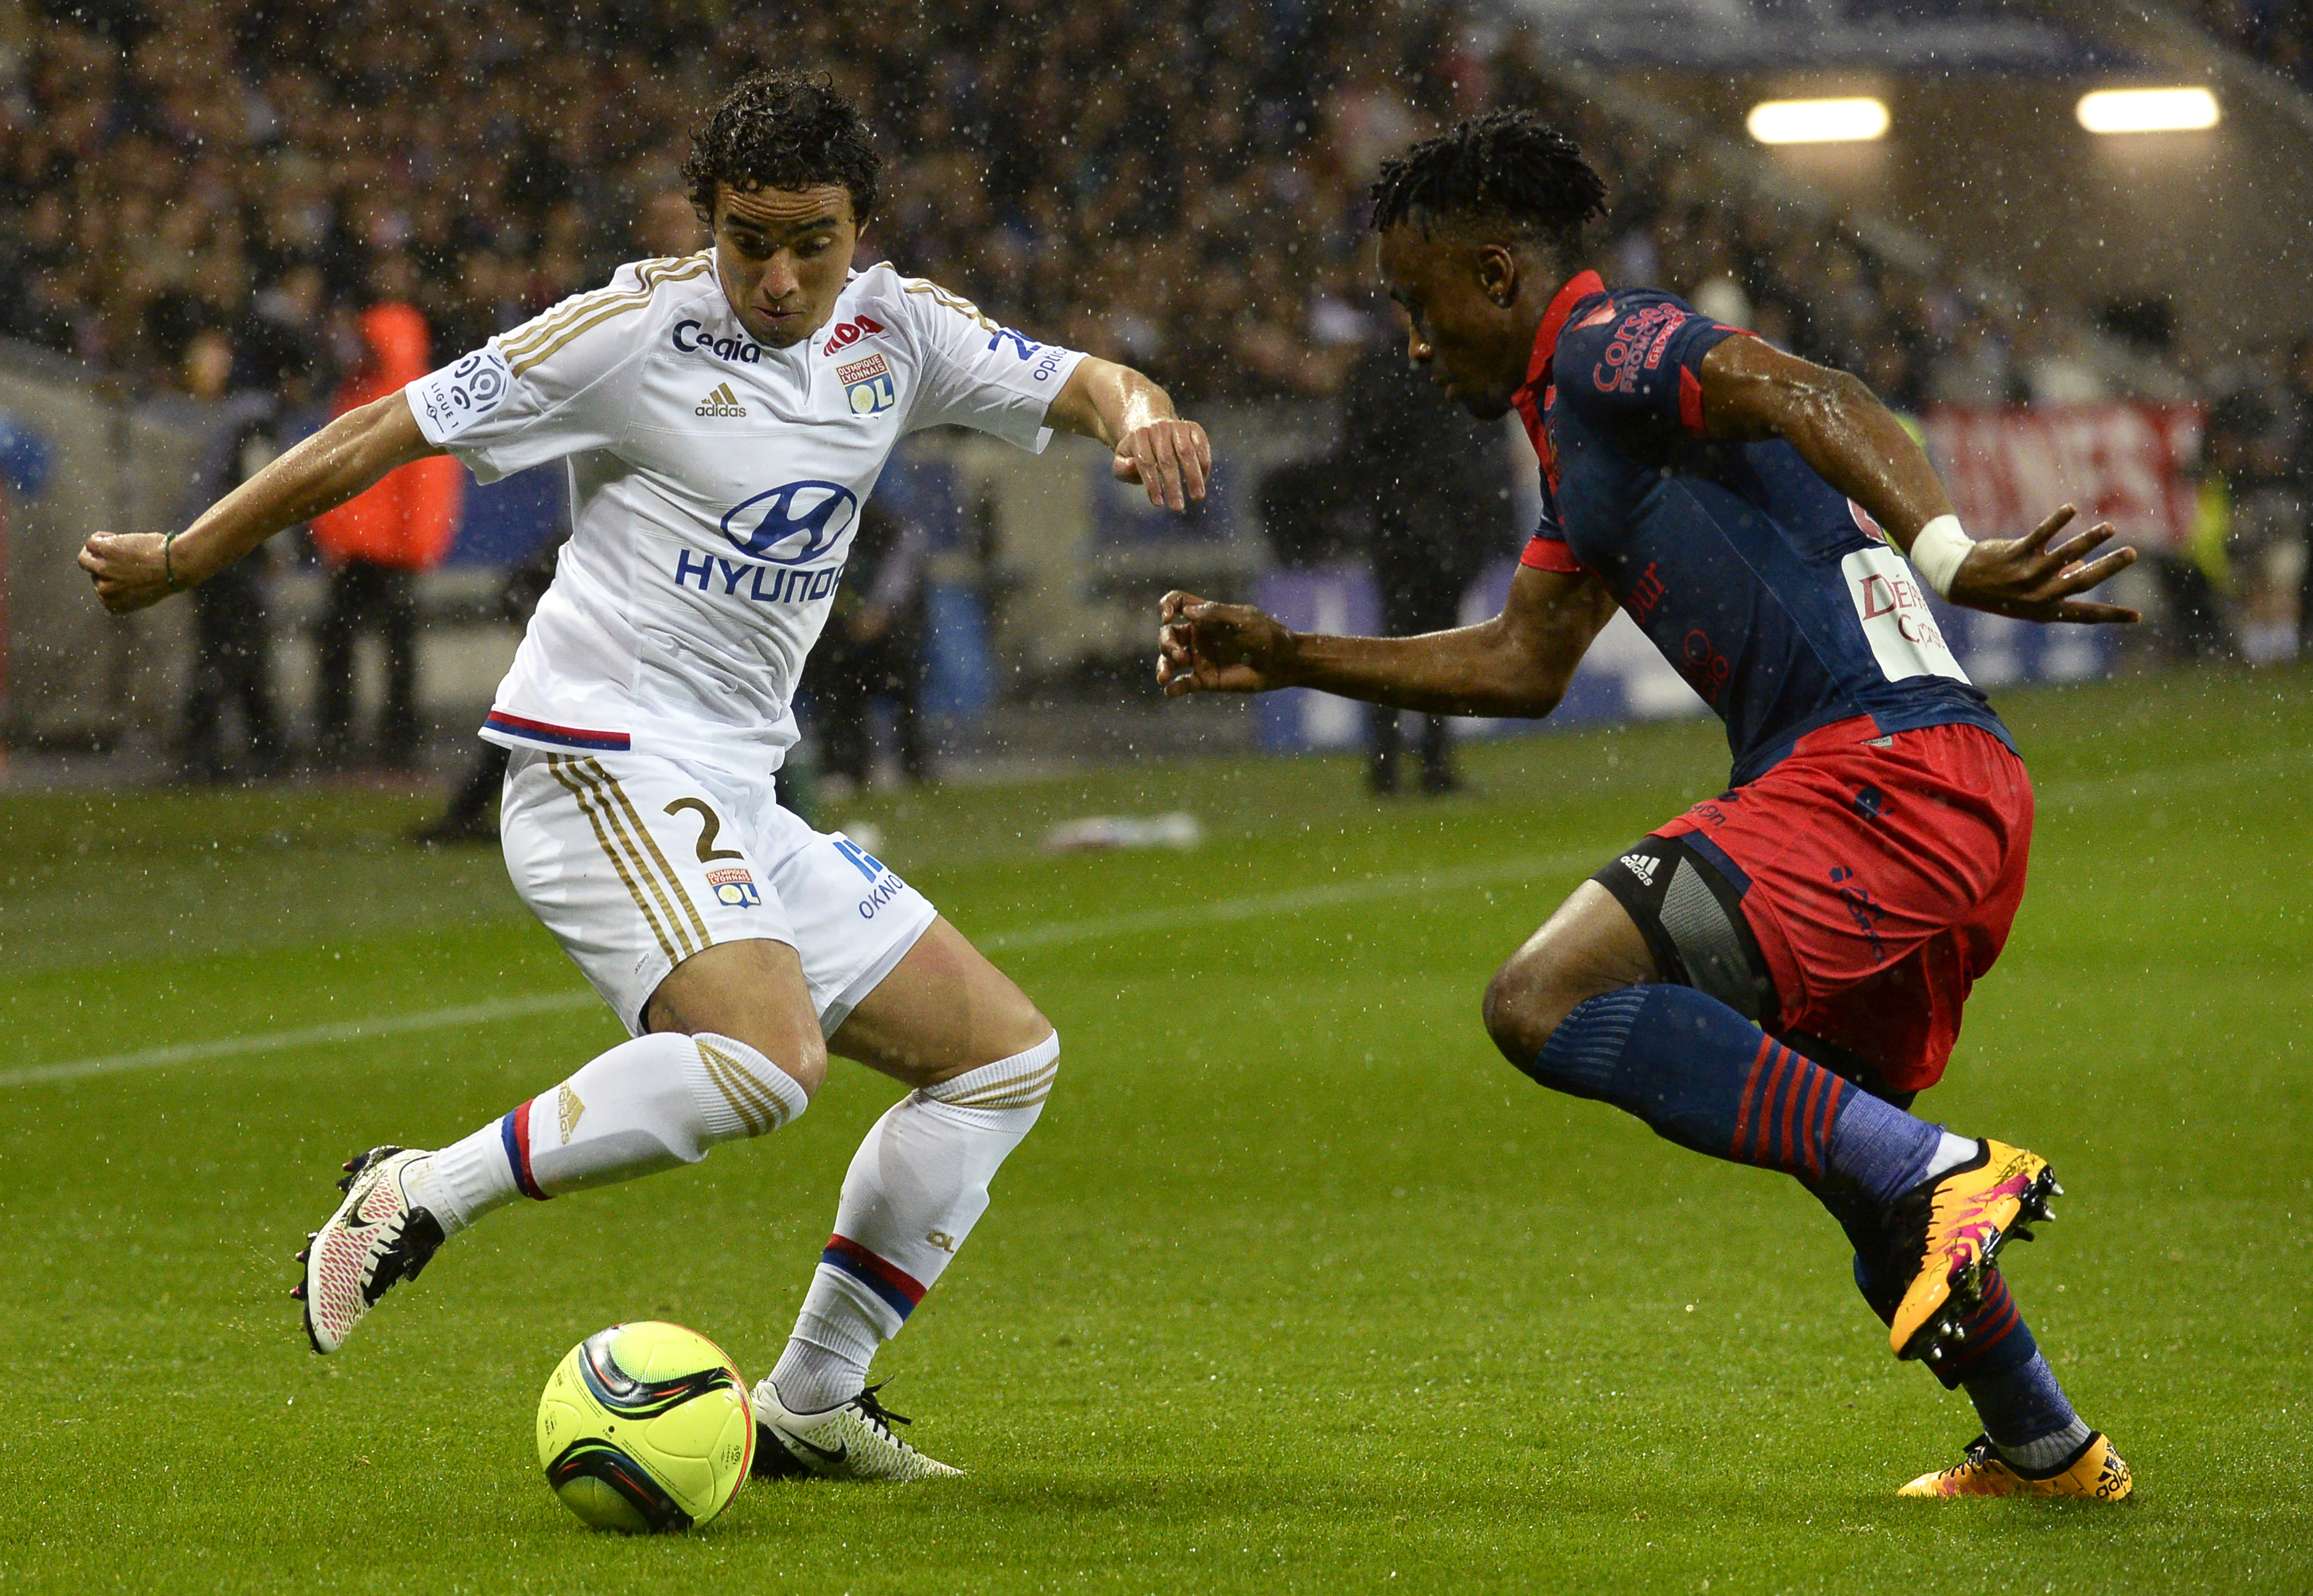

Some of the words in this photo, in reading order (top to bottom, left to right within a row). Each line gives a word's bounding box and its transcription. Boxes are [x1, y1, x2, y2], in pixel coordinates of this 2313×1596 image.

[838, 355, 881, 376] OLYMPIQUE
[841, 363, 885, 384] LYONNAIS
[430, 382, 454, 419] LIGUE
[851, 378, 893, 414] OL
[695, 404, 747, 417] adidas
[663, 797, 745, 863] 2
[707, 869, 747, 879] OLYMPIQUE
[710, 874, 751, 885] LYONNAIS
[1620, 856, 1653, 886] adidas
[718, 884, 760, 903] OL
[859, 874, 903, 919] OKNO
